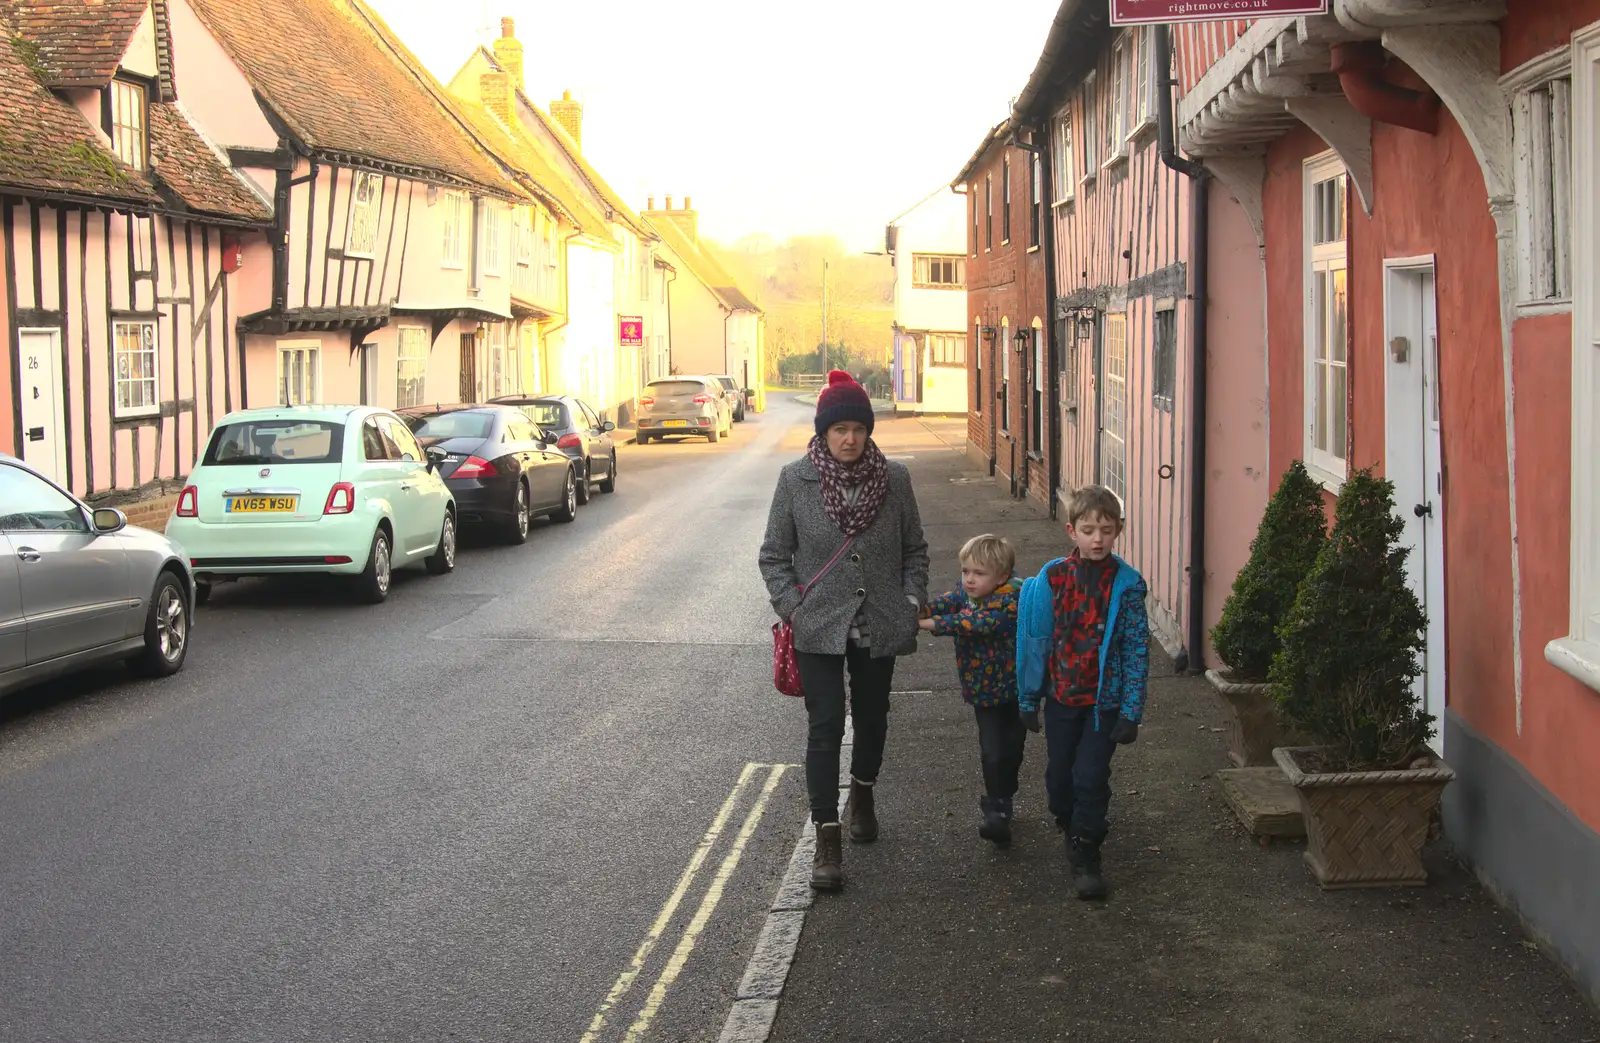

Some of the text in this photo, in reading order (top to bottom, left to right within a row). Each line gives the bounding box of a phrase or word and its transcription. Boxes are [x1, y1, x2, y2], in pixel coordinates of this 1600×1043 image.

[1168, 0, 1268, 13] rightmove.co.uk
[28, 355, 38, 369] 26
[234, 498, 266, 511] AV65
